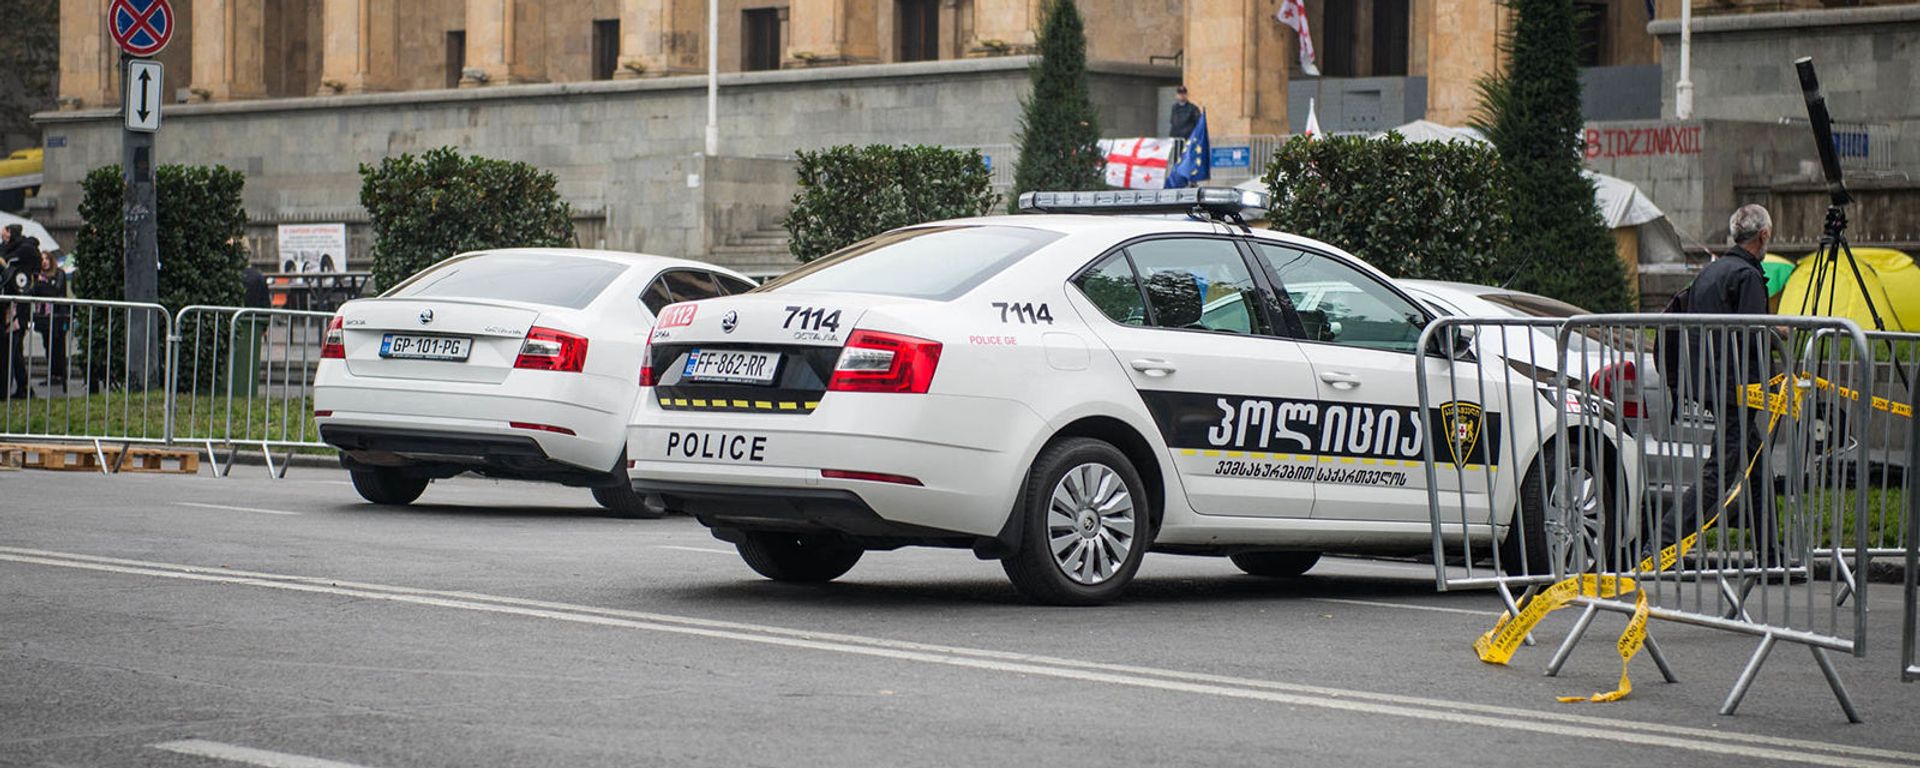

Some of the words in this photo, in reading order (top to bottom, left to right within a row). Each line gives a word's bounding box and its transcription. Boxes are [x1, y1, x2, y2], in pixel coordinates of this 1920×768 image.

[672, 304, 696, 325] 112
[783, 306, 842, 332] 7114
[992, 302, 1053, 325] 7114
[393, 337, 460, 355] GP-101-PG
[969, 336, 1002, 345] POLICE
[1005, 336, 1017, 346] GE
[696, 352, 767, 377] FF-862-RR
[1208, 398, 1424, 457] პოლიცია
[667, 432, 767, 461] POLICE
[1215, 460, 1315, 480] ვემსახურებით
[1317, 467, 1407, 486] საქართველოს
